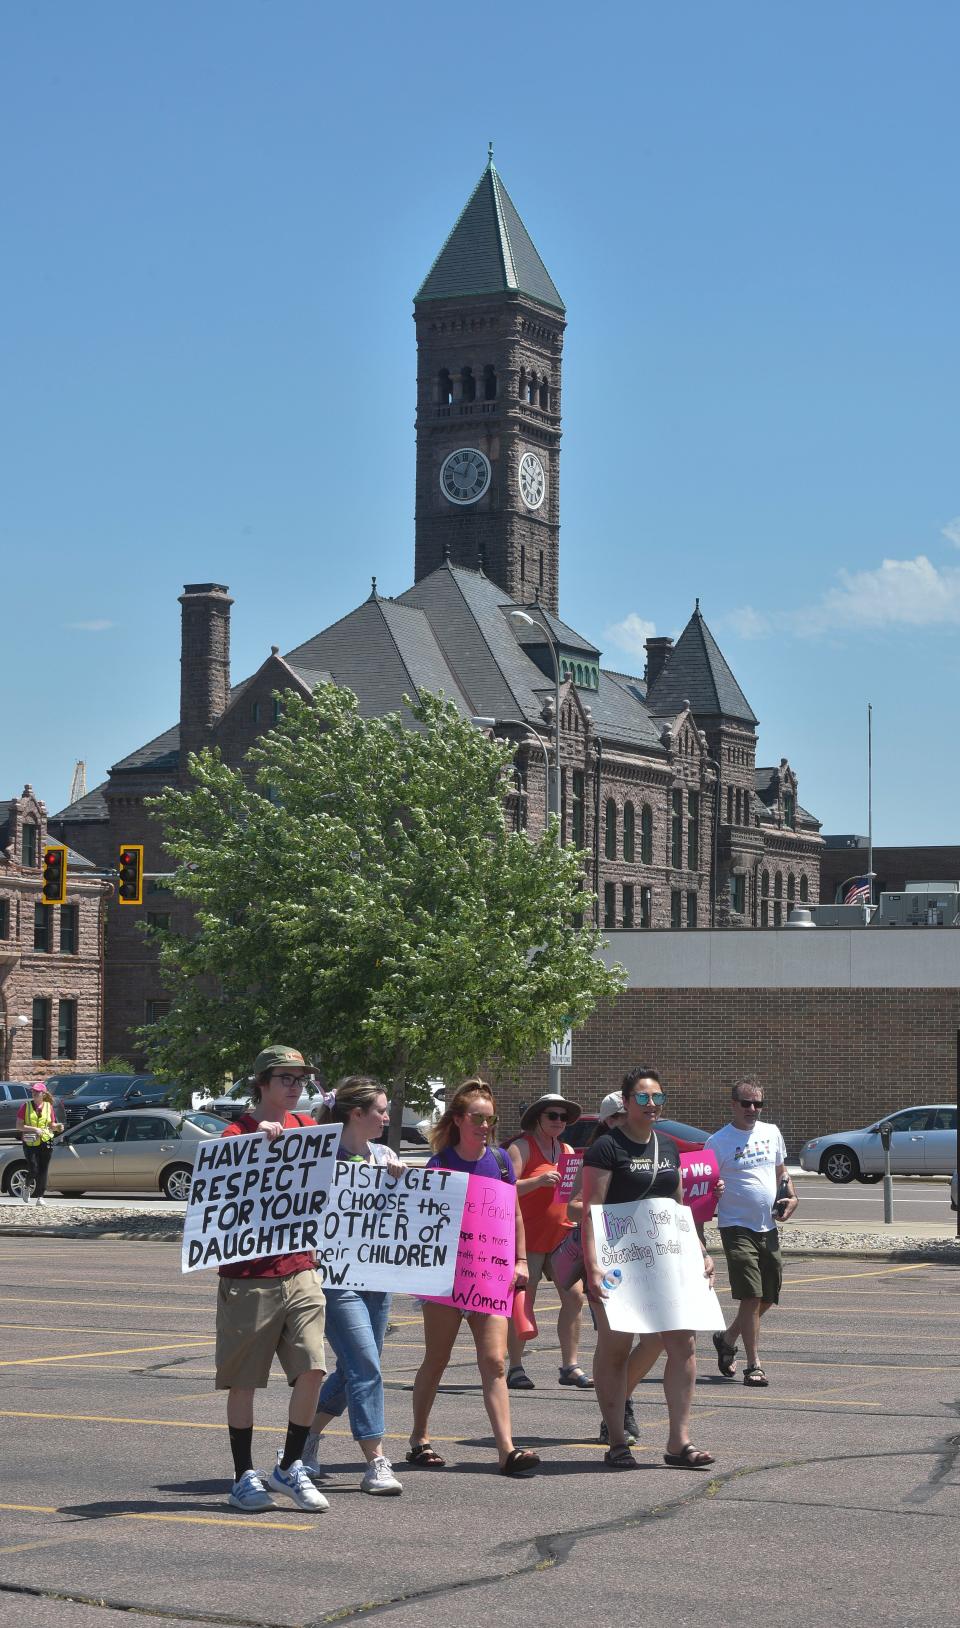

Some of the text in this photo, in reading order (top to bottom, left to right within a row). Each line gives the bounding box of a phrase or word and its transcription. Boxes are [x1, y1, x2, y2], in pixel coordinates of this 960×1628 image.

[197, 1133, 336, 1171] HAVE SOME
[190, 1161, 317, 1205] RESPECT
[332, 1162, 451, 1191] PISTS GET
[690, 1163, 712, 1177] We
[338, 1189, 450, 1216] CHOOSE the
[689, 1182, 710, 1197] All
[202, 1190, 327, 1233] FOR YOUR
[647, 1209, 671, 1239] just
[324, 1212, 451, 1243] OTHER of
[460, 1231, 474, 1242] ape
[188, 1220, 318, 1267] DAUGHTER
[357, 1244, 447, 1267] CHILDREN
[601, 1242, 656, 1268] Standing
[491, 1255, 509, 1266] rape
[452, 1284, 508, 1311] Women
